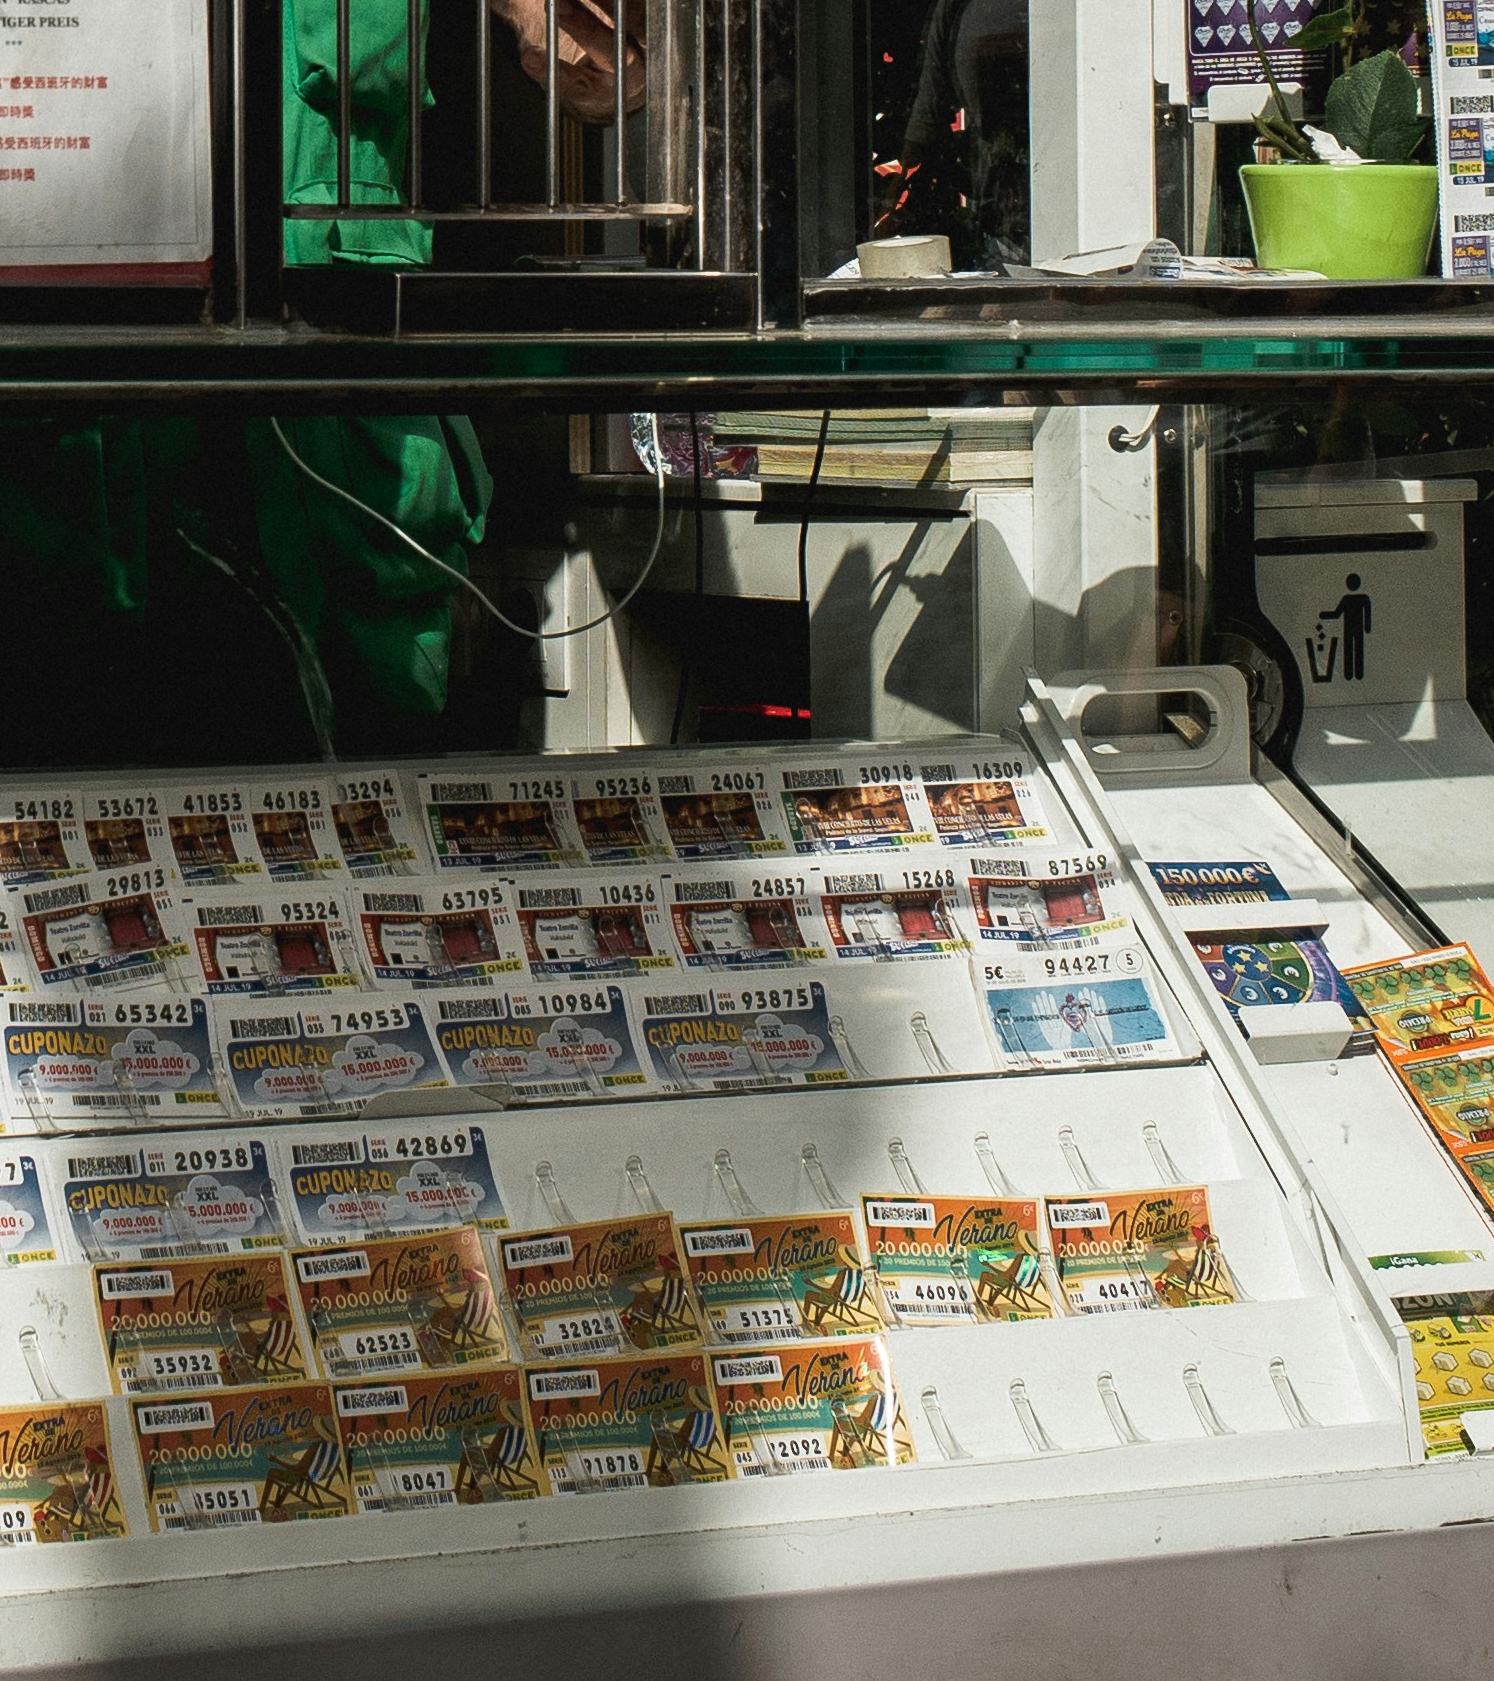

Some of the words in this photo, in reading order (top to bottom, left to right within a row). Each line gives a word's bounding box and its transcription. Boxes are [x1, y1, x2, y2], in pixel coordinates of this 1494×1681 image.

[39, 16, 80, 28] PREIS
[860, 764, 912, 784] 30918
[972, 762, 1023, 779] 16309
[509, 781, 564, 800] 71245
[595, 777, 652, 796] 95236
[711, 772, 765, 792] 24067
[15, 799, 74, 820] 54182
[98, 797, 159, 817] 53672
[183, 793, 242, 813] 41853
[263, 791, 321, 811] 46183
[1048, 855, 1108, 875] 87569
[106, 871, 167, 896] 29813
[752, 877, 806, 898] 24857
[902, 869, 956, 889] 15268
[442, 887, 504, 910] 63795
[599, 884, 655, 905] 10436
[280, 901, 341, 922] 95324
[1044, 954, 1110, 976] 94427
[538, 992, 607, 1014] 10984
[740, 987, 810, 1011] 93875
[114, 1003, 188, 1024] 65342
[331, 1007, 405, 1032] 74953
[9, 1031, 108, 1055] CUPONAZO
[440, 1026, 534, 1051] CUPONAZO
[396, 1134, 467, 1157] 42869
[175, 1148, 249, 1172] 20938
[295, 1170, 394, 1195] CUPONAZO
[739, 1309, 793, 1328] 51375
[355, 1334, 411, 1355] 62523
[153, 1355, 213, 1375] 35932
